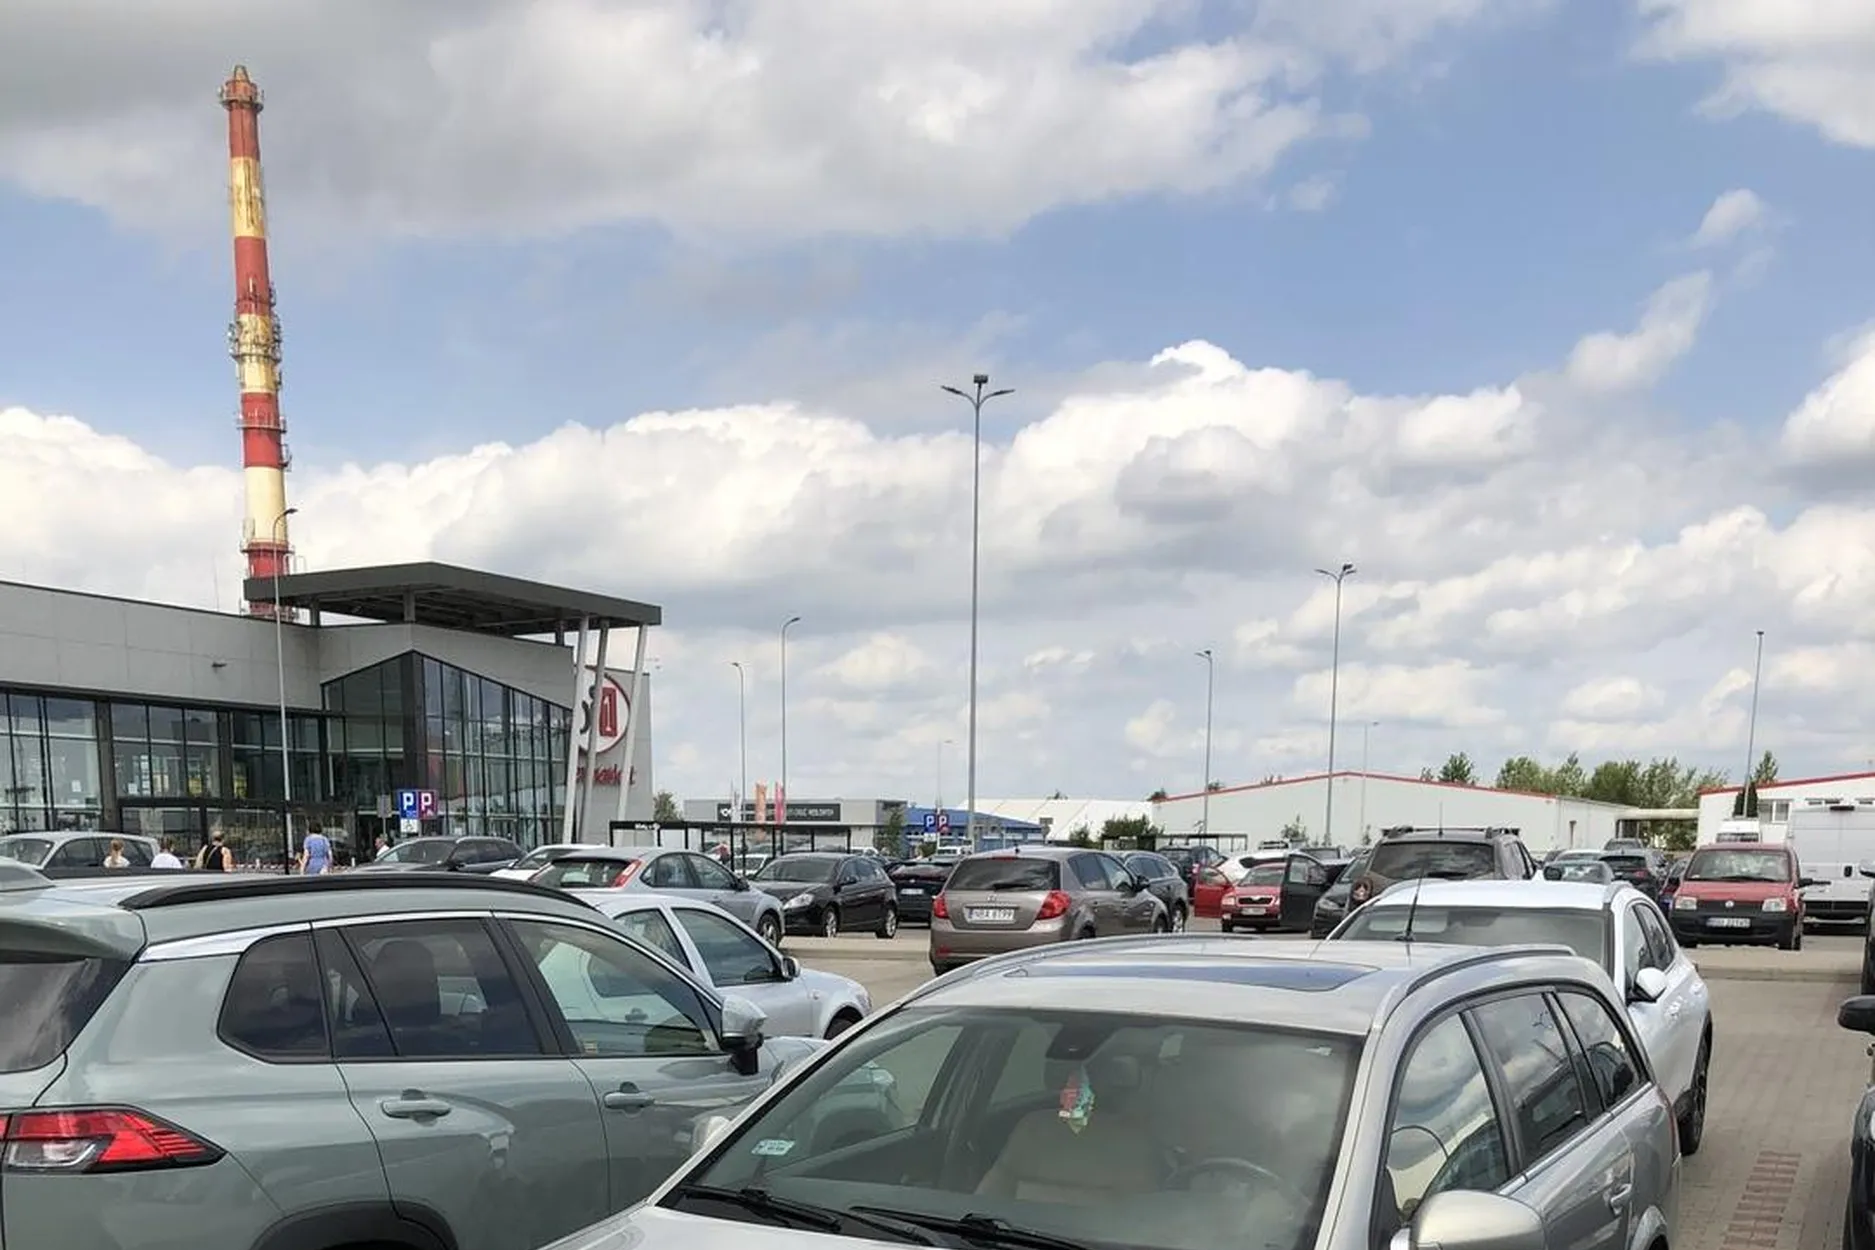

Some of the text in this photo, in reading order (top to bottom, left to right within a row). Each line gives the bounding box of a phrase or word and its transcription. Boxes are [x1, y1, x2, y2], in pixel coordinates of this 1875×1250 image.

[402, 792, 414, 811] P
[421, 792, 432, 811] P
[926, 815, 935, 828] P
